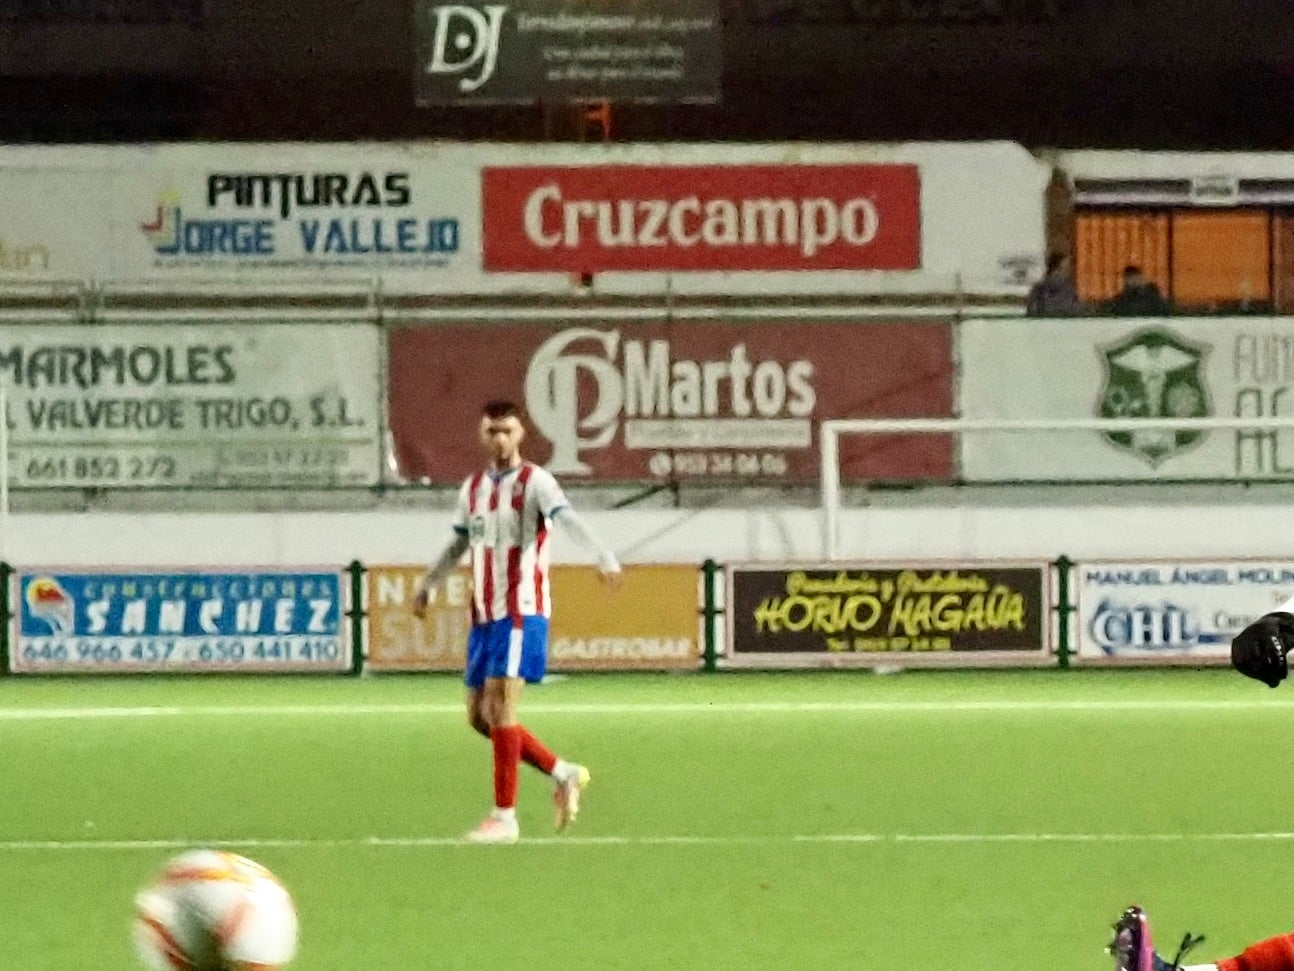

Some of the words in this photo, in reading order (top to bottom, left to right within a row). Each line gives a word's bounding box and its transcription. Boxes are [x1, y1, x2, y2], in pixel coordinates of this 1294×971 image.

[207, 173, 412, 219] PINTURAS
[523, 184, 880, 257] Cruzcampo
[155, 206, 275, 257] JORGE
[302, 219, 459, 254] VALLEJO
[624, 339, 817, 418] Martos
[27, 398, 184, 431] VALVERDE
